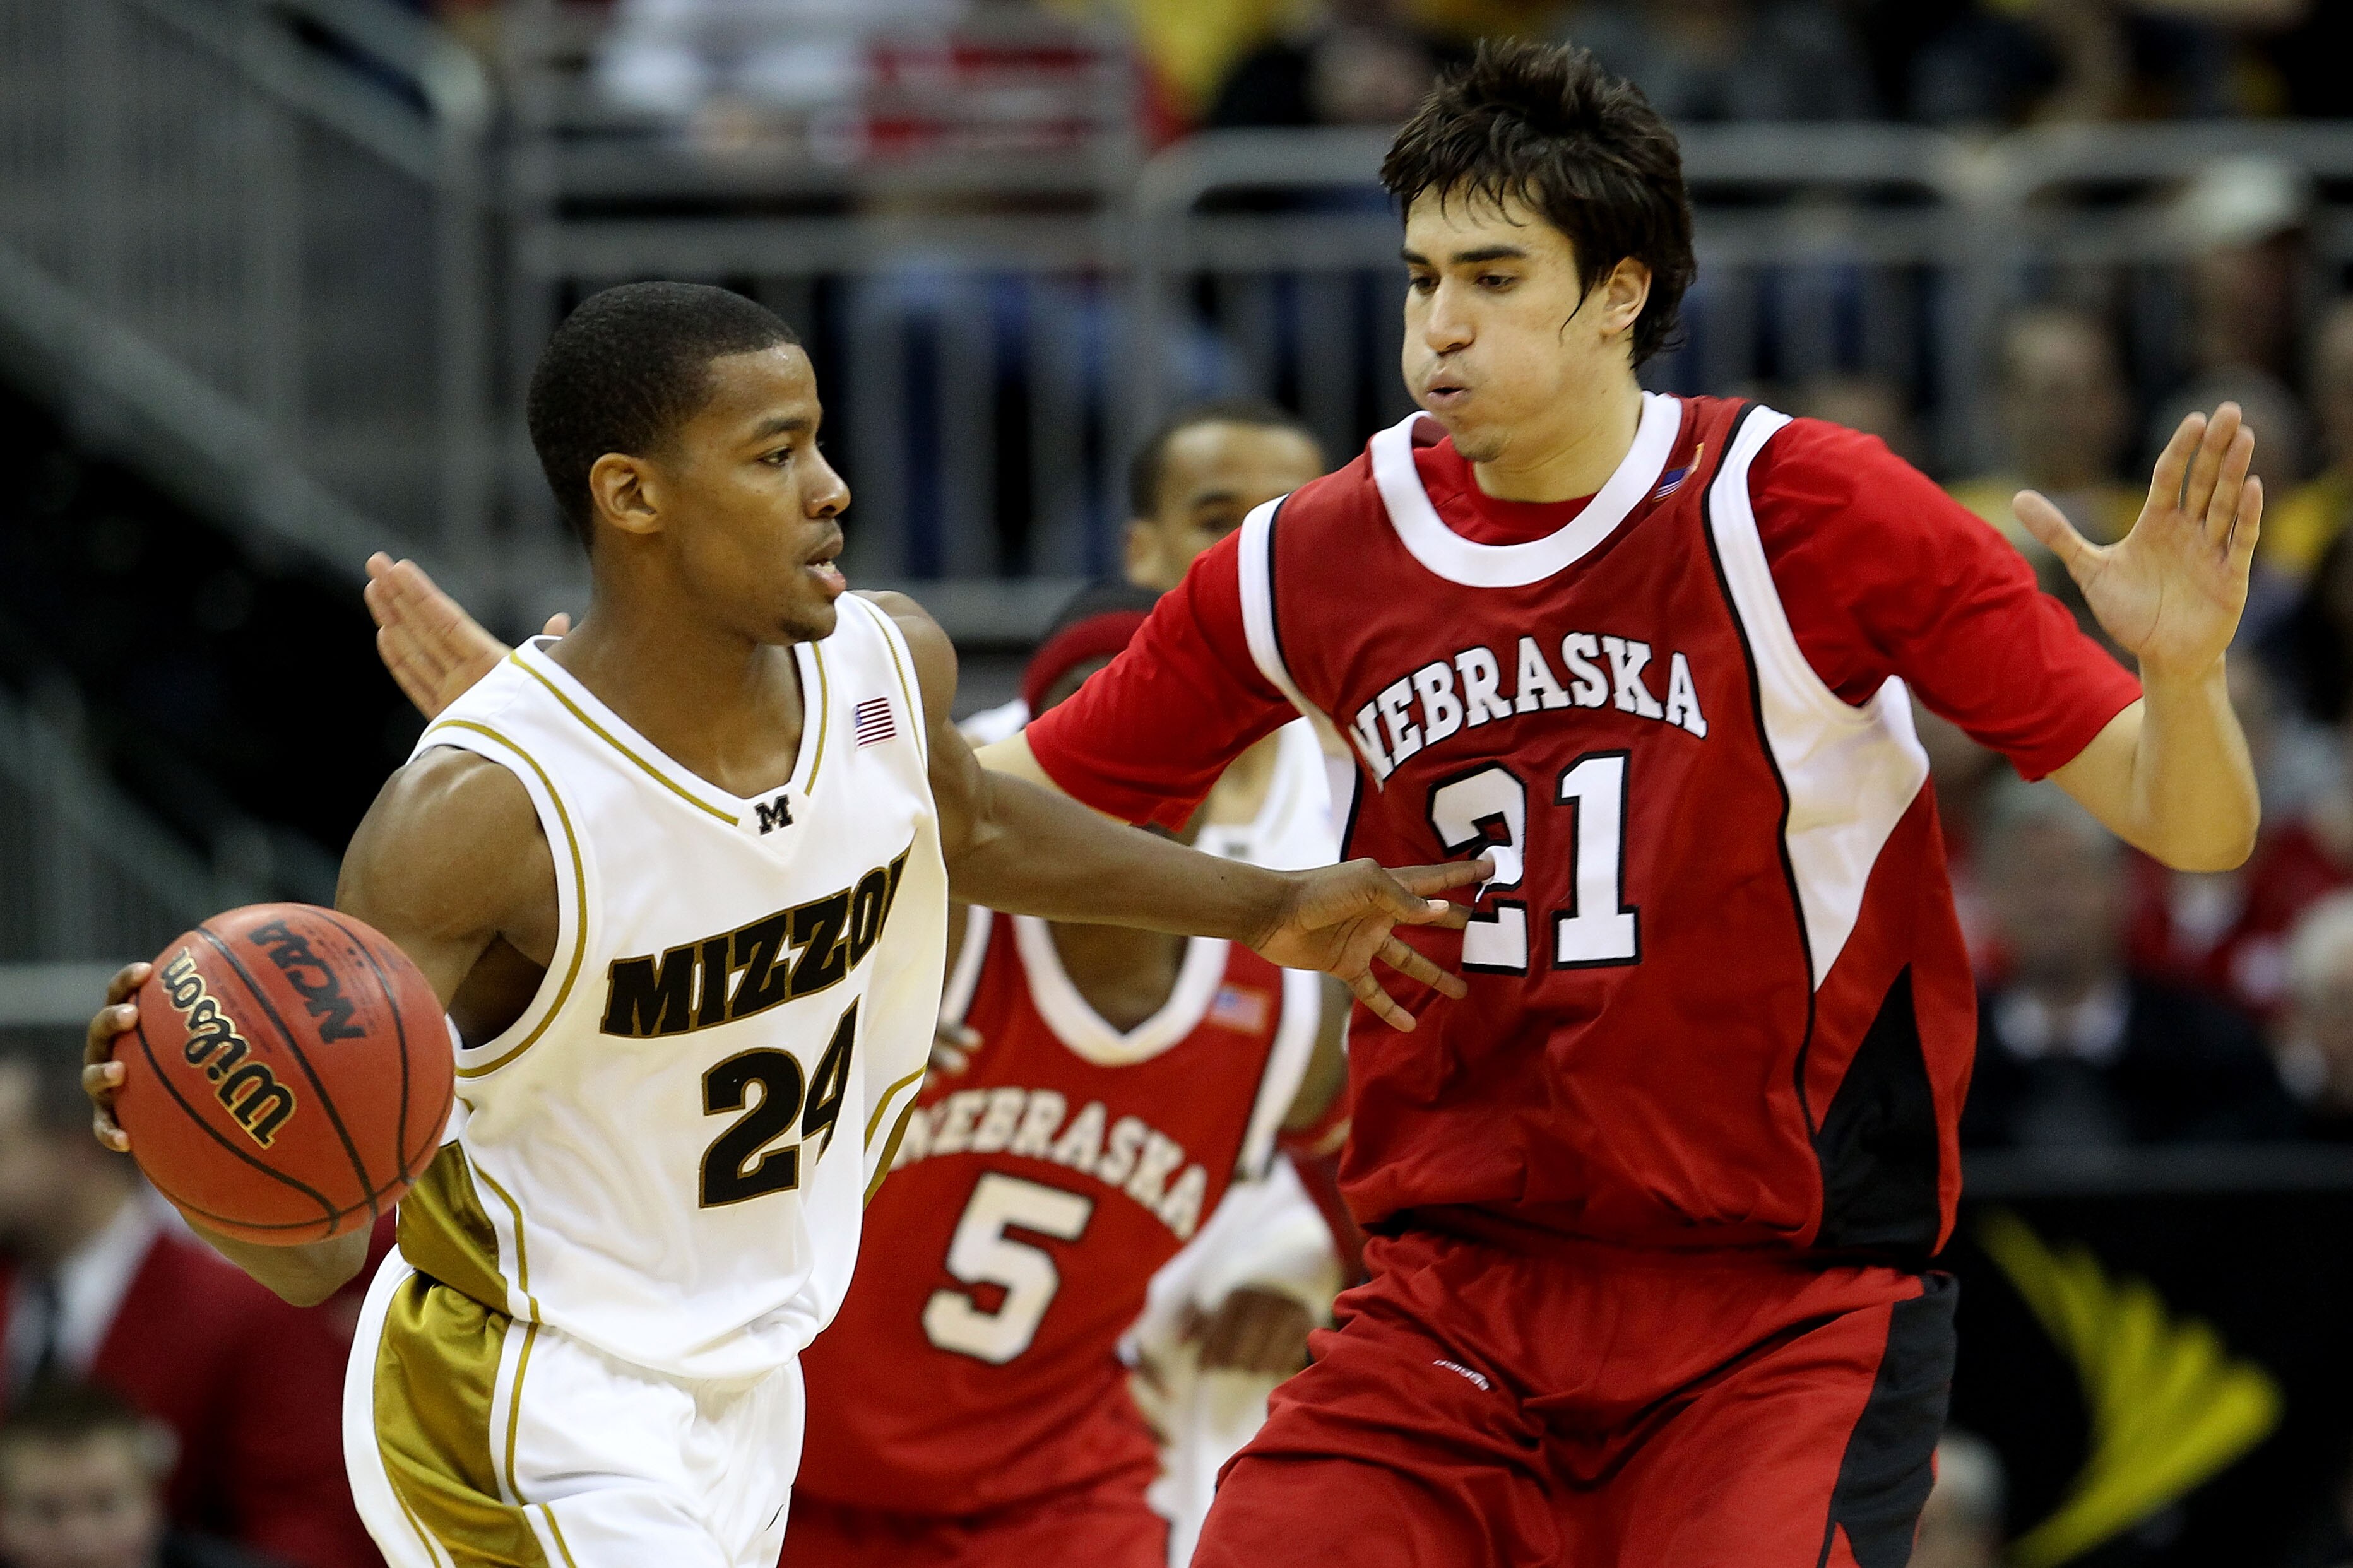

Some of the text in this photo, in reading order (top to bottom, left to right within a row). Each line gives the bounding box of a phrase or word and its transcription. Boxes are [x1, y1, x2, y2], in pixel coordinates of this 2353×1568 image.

[1348, 632, 1708, 793] NEBRASKA
[754, 794, 793, 835] M
[1426, 748, 1642, 977] 21
[159, 946, 297, 1149] Wilson
[247, 919, 368, 1044] NCAA
[698, 994, 861, 1209] 24
[920, 1169, 1096, 1366] 5
